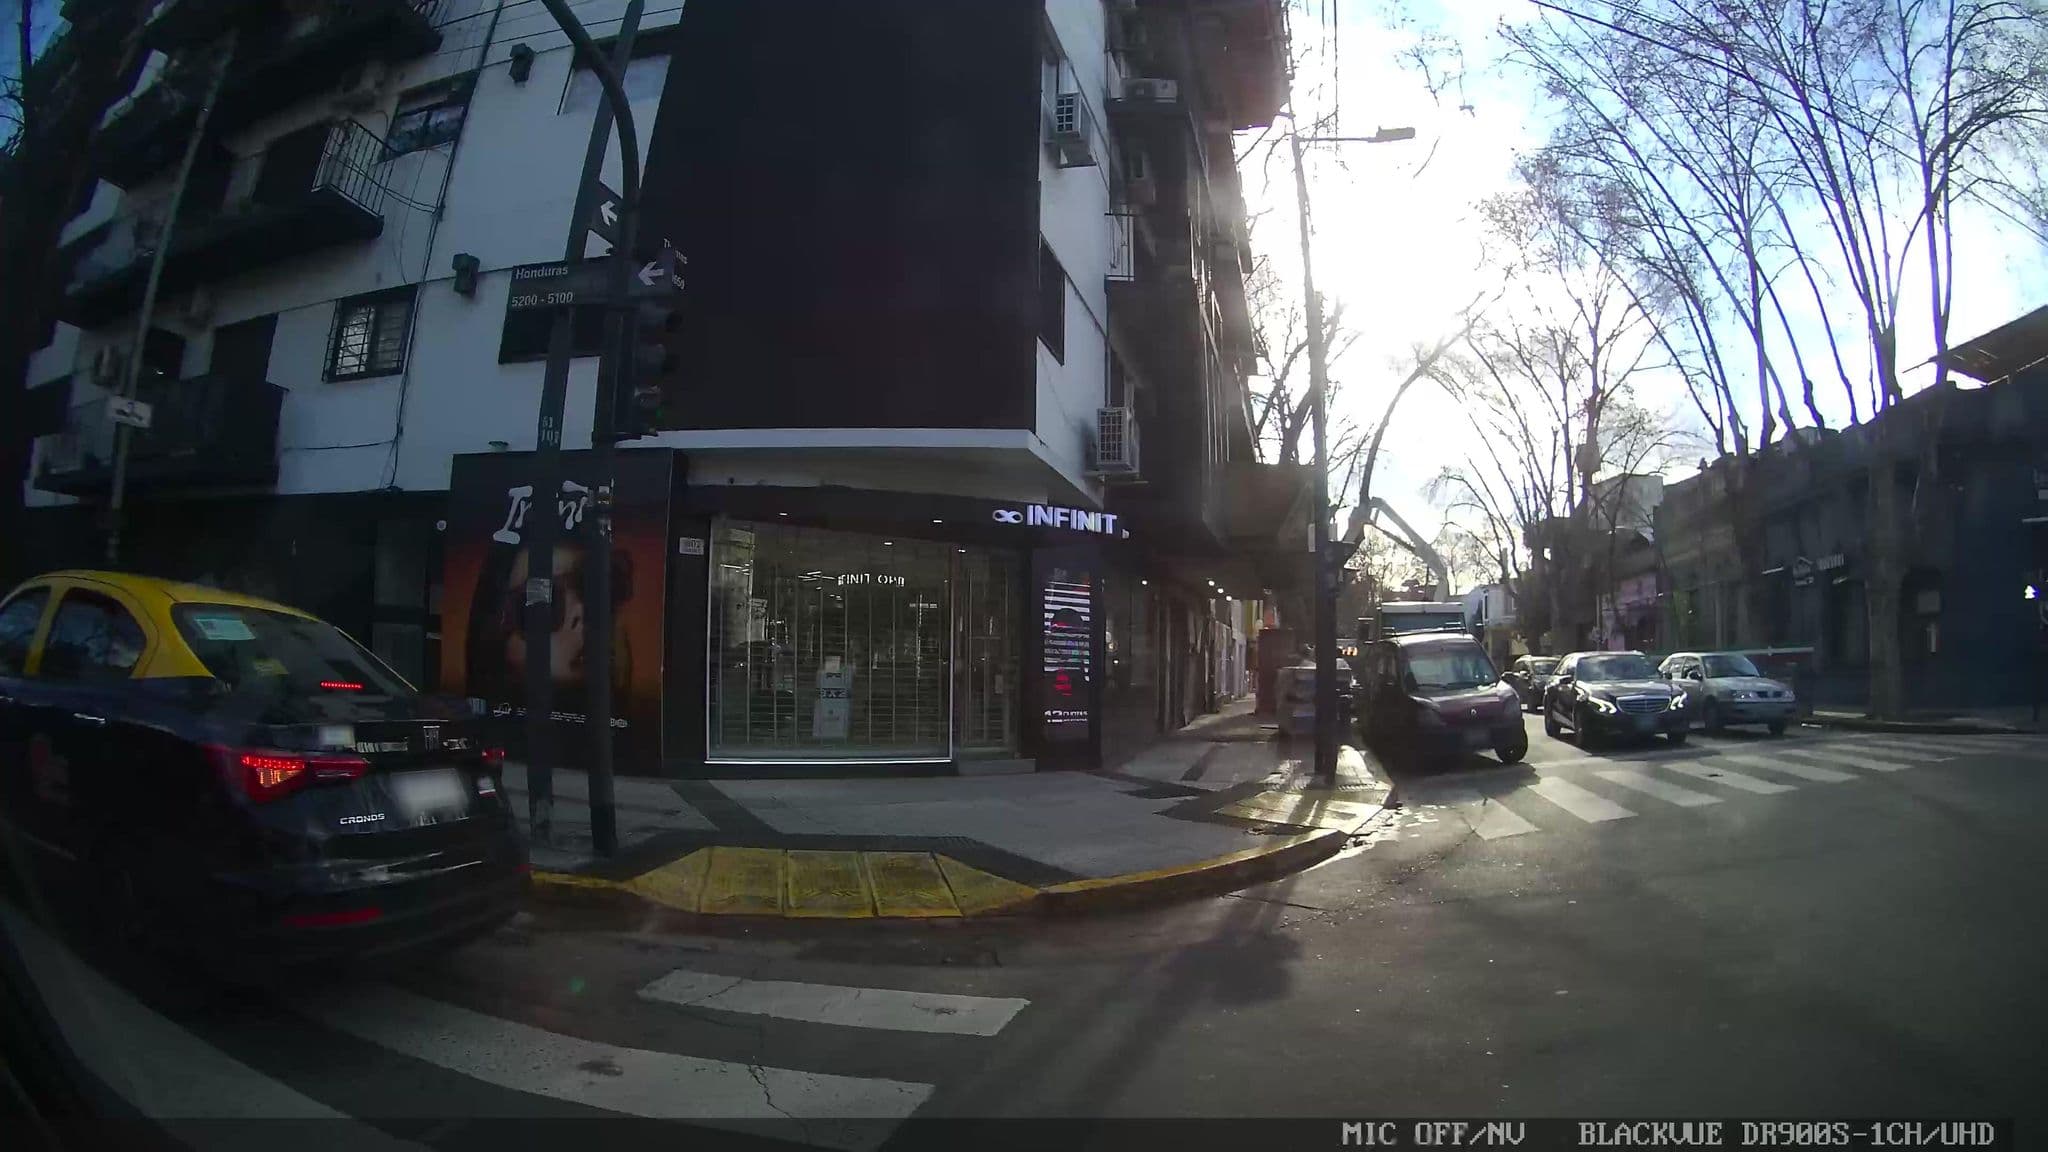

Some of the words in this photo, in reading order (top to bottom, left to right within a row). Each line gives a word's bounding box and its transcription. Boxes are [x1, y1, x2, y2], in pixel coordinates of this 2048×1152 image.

[515, 265, 569, 280] Honduras
[511, 294, 538, 307] 5200
[547, 291, 574, 304] 5100
[1026, 503, 1118, 535] INFINIT
[340, 812, 386, 825] CRONOS
